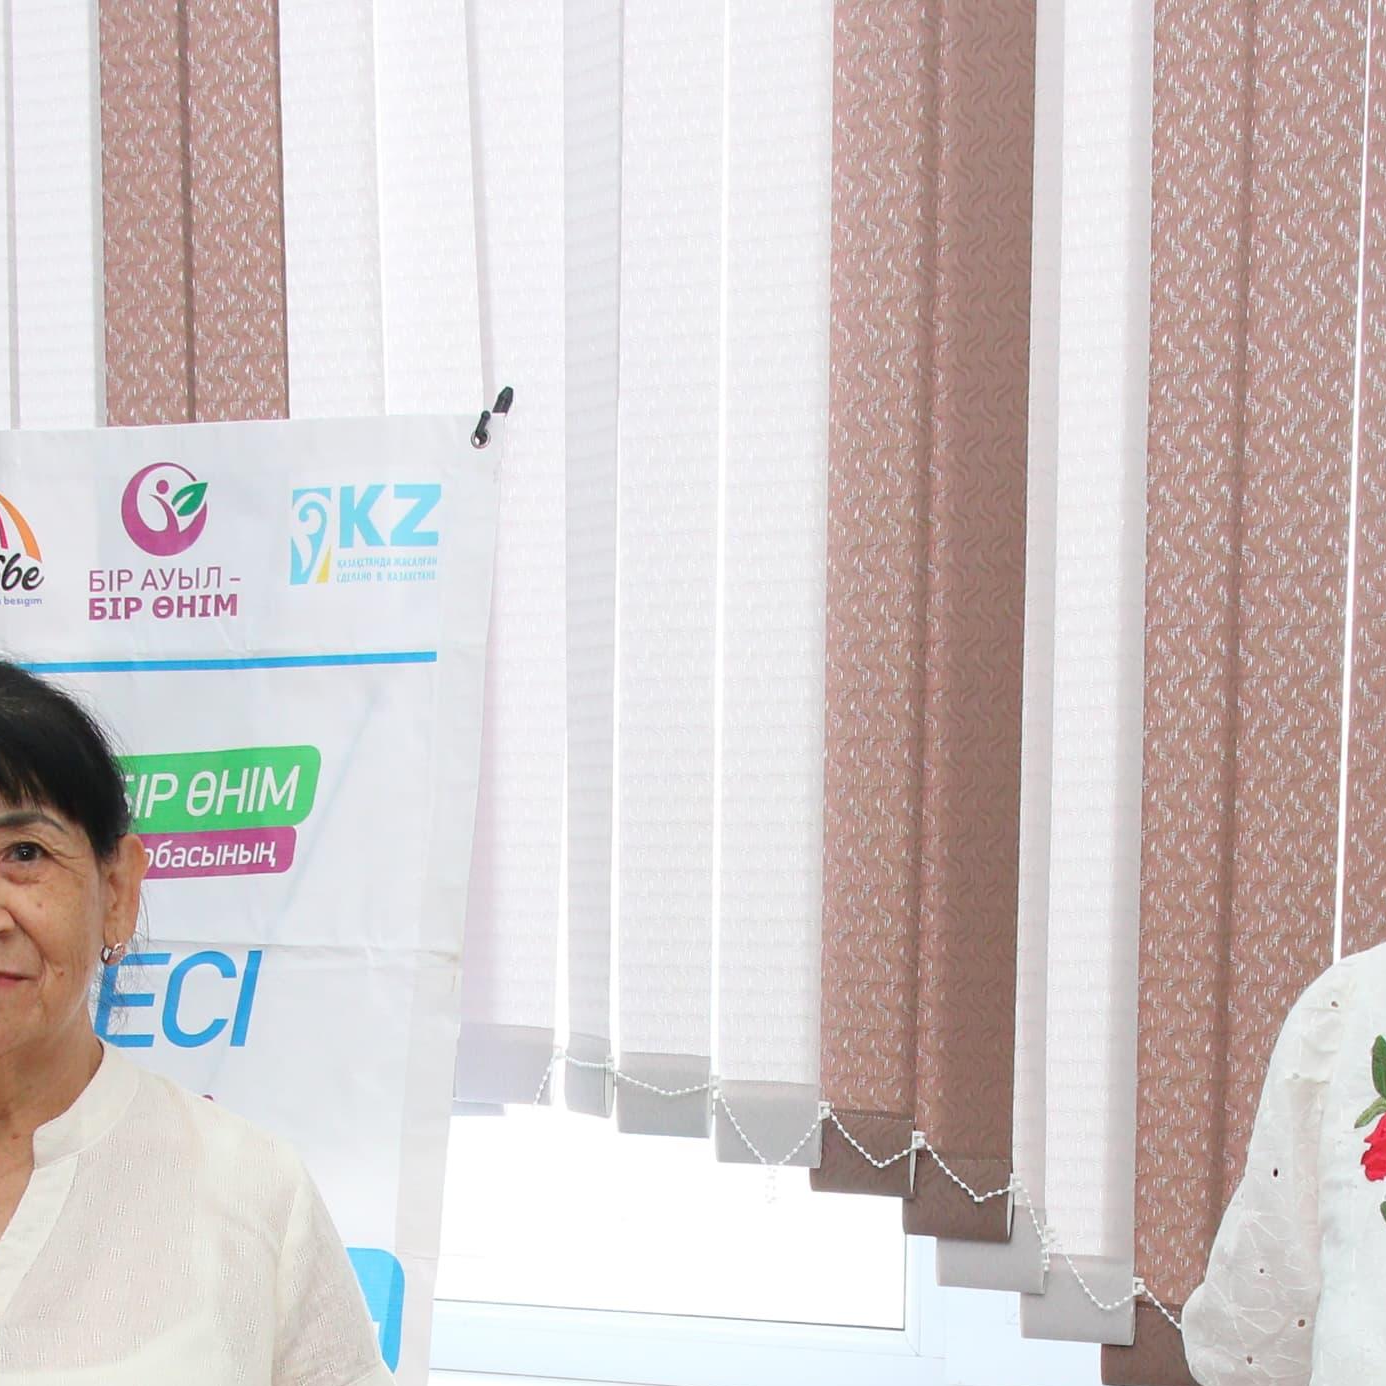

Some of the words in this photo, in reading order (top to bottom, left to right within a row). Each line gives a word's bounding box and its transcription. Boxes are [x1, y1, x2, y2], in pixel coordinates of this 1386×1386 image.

[338, 483, 443, 549] KZ
[88, 568, 134, 593] БІР
[140, 566, 223, 592] АУЫЛ
[88, 596, 144, 621] БІР
[151, 593, 239, 620] ӨНІМ
[185, 764, 302, 818] ӨНІМ
[144, 840, 277, 868] обасының
